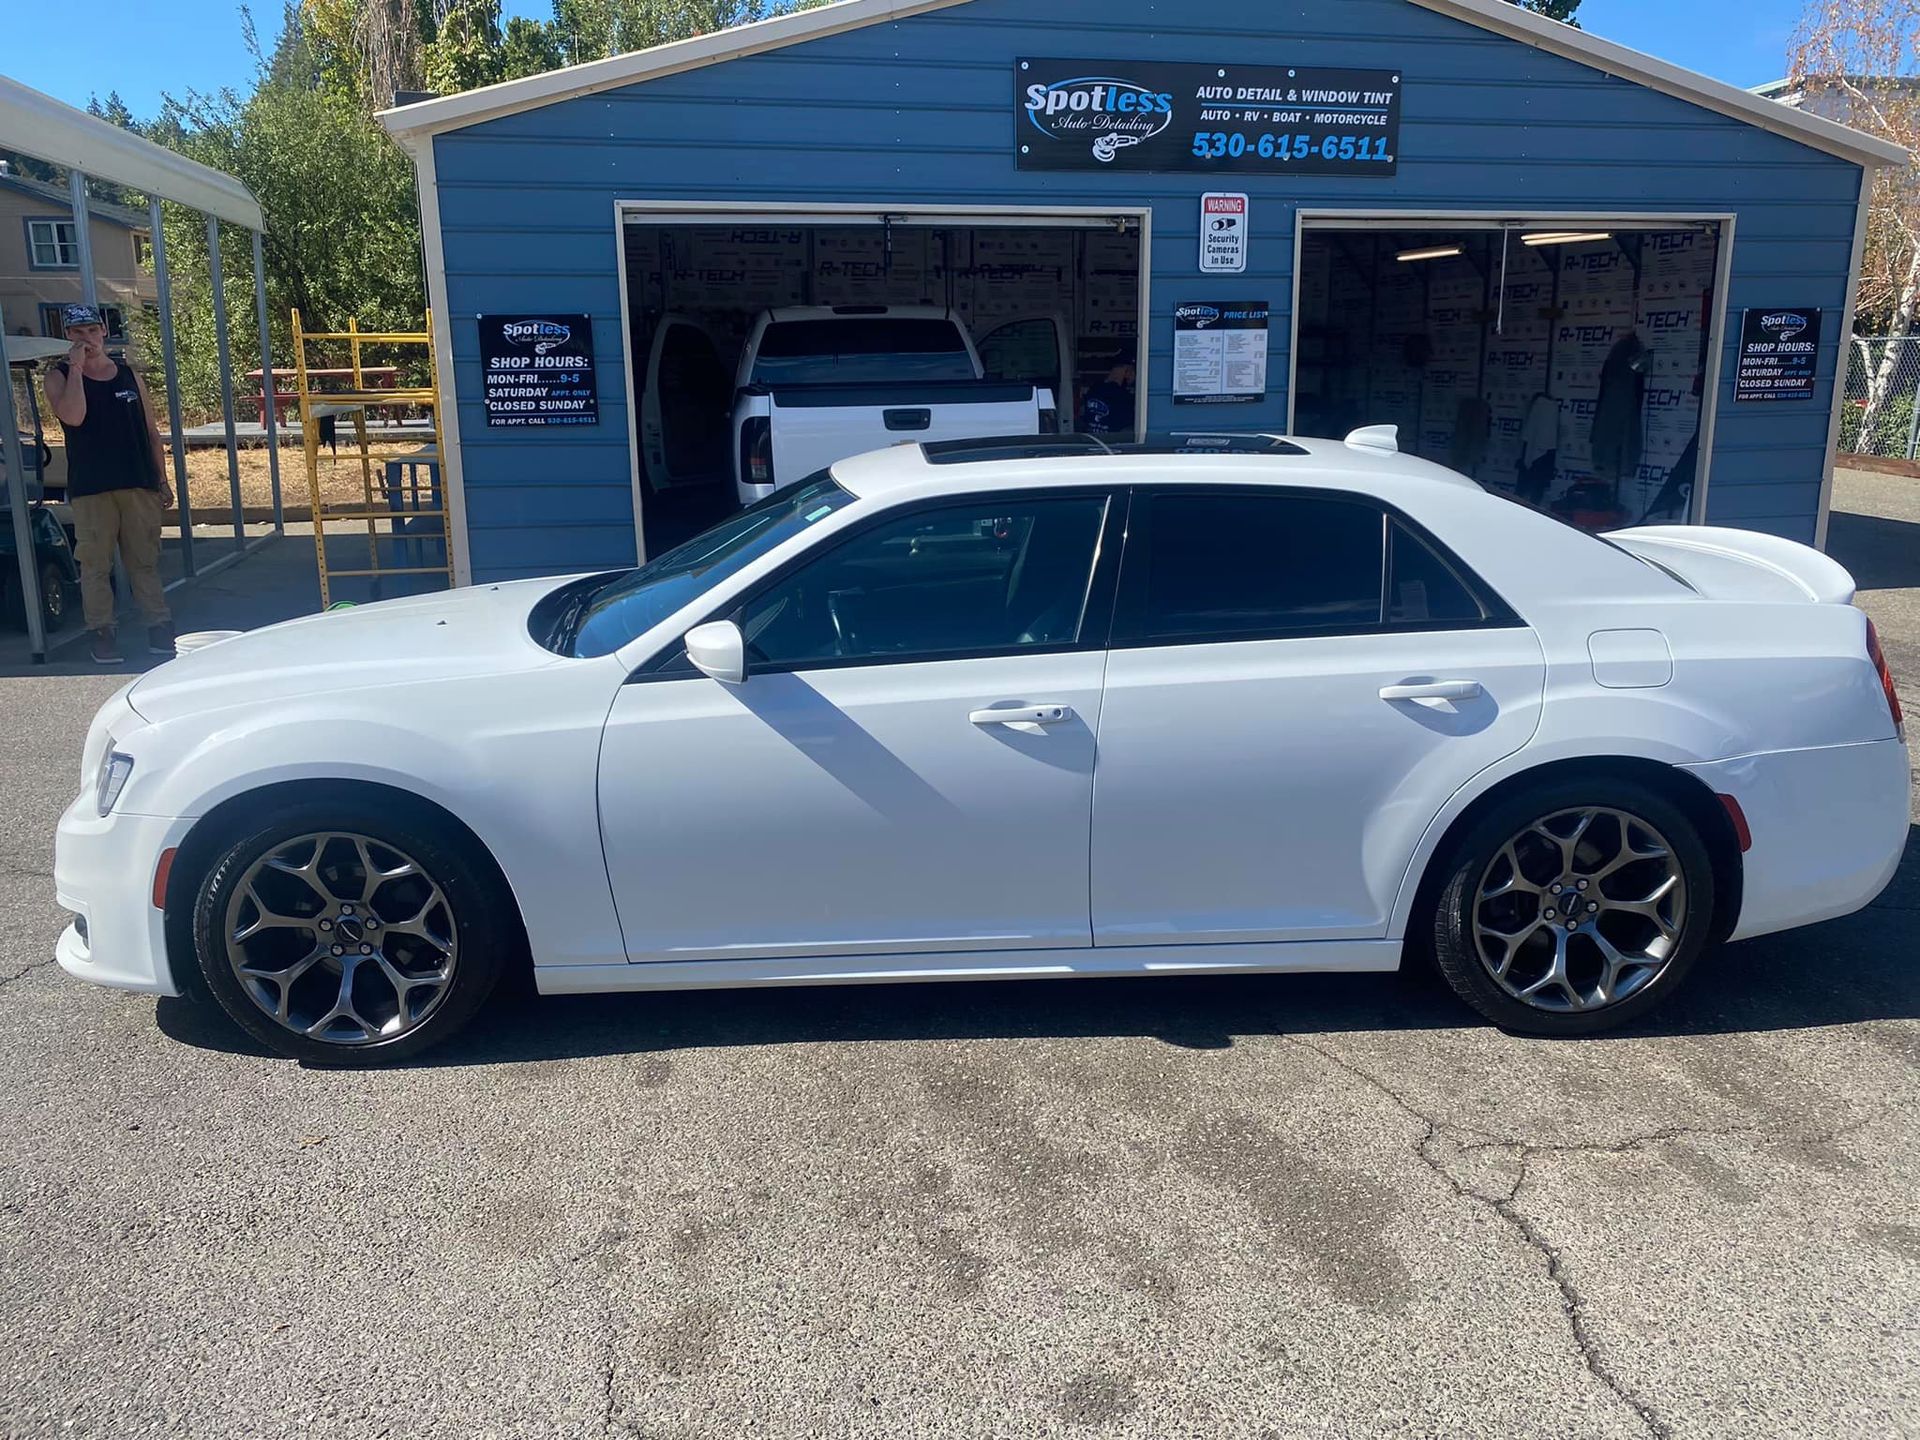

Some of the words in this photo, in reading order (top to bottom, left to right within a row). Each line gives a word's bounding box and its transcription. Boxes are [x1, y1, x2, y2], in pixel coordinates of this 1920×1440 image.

[1024, 84, 1173, 115] Spotless
[1196, 86, 1233, 99] AUTO
[1236, 88, 1283, 101] DETAIL
[1287, 89, 1298, 101] &
[1302, 90, 1360, 103] WINDOW
[1363, 92, 1393, 104] TINT
[1200, 110, 1231, 121] AUTO
[1244, 111, 1260, 122] RV
[1272, 112, 1302, 123] BOAT
[1314, 113, 1388, 125] MOTORCYCLE
[1051, 113, 1089, 129] Auto
[1091, 112, 1155, 137] Detailing
[1193, 132, 1389, 161] 530-615-6511
[1207, 199, 1242, 211] WARNING
[1208, 234, 1239, 244] Security
[1643, 232, 1693, 250] -TECH
[1207, 245, 1239, 254] Cameras
[1211, 256, 1219, 264] In
[1220, 256, 1234, 264] Use
[1564, 252, 1620, 271] R-TECH
[819, 261, 887, 277] R-TECH
[1224, 311, 1248, 319] PRICE
[1248, 311, 1266, 319] LIST
[1426, 309, 1461, 322] -TECH
[503, 323, 570, 337] Spotless
[1089, 321, 1137, 333] R-TEC
[1558, 326, 1614, 342] R-TECH
[1747, 343, 1775, 352] SHOP
[1777, 342, 1815, 352] HOURS:
[490, 357, 530, 369] SHOP
[534, 356, 588, 368] HOURS:
[1741, 368, 1783, 377] SATURDAY
[1740, 379, 1771, 388] CLOSED
[1773, 378, 1806, 387] SUNDAY
[488, 387, 549, 398] SATURDAY
[1643, 389, 1683, 406] TECH
[489, 401, 536, 411] CLOSED
[539, 400, 586, 410] SUNDAY
